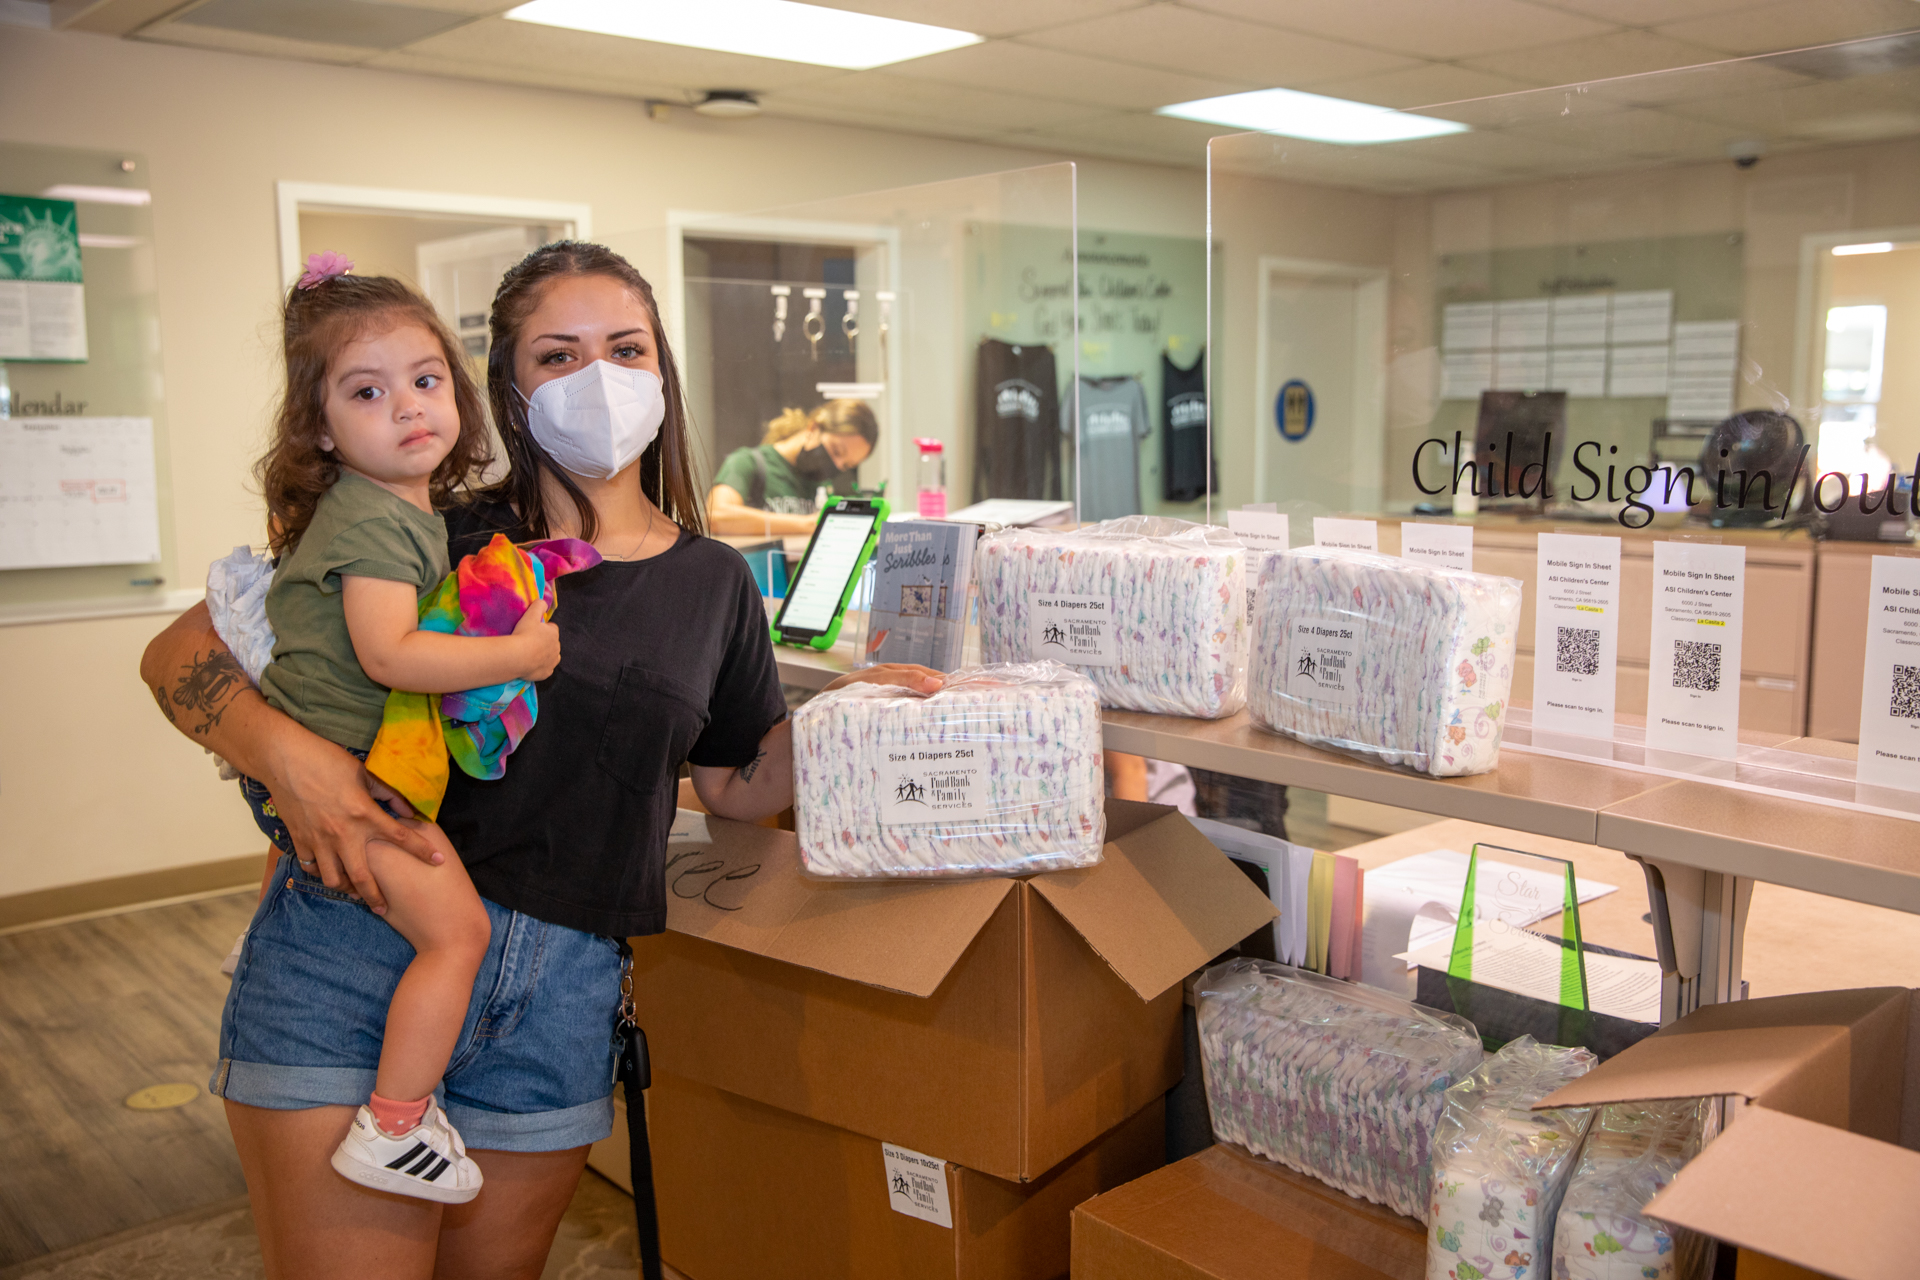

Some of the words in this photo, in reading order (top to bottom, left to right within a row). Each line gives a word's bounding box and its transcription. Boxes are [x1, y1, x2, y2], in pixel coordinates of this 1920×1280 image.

[0, 390, 88, 416] alendar
[1412, 431, 1554, 500] Child
[1570, 441, 1700, 529] Sign
[885, 532, 908, 543] More
[909, 530, 932, 542] Than
[893, 543, 913, 555] Just
[1449, 550, 1464, 558] Sheet
[884, 547, 936, 573] Scribbles
[1569, 561, 1583, 569] Sign
[1559, 576, 1589, 584] Children's
[1663, 569, 1686, 577] Mobile
[1687, 571, 1703, 580] Sign
[1714, 573, 1735, 581] Sheet
[1677, 587, 1709, 596] Children's
[1882, 586, 1910, 596] Mobile
[1038, 599, 1052, 607] Size
[1060, 600, 1087, 610] Diapers
[1089, 601, 1105, 610] 25ct
[1899, 606, 1920, 615] Child
[1064, 618, 1107, 626] SACRAMENTO
[1298, 625, 1310, 634] Size
[1310, 626, 1315, 634] 4
[1316, 627, 1339, 638] Diapers
[1339, 629, 1353, 639] 25ct
[1882, 628, 1918, 637] Sacramento,
[1316, 647, 1353, 657] SACRAMENTO
[1318, 682, 1345, 691] SERVICES
[1661, 718, 1680, 726] Please
[888, 753, 907, 762] Size
[909, 752, 915, 760] 4
[918, 751, 952, 761] Diapers
[955, 749, 974, 758] 25ct
[1875, 750, 1898, 759] Please
[923, 769, 978, 777] SACRAMENTO
[936, 788, 966, 801] Family
[931, 802, 973, 810] SERVICES
[1498, 871, 1540, 900] Star
[884, 1148, 895, 1158] Size
[900, 1153, 919, 1165] Diapers
[906, 1170, 939, 1184] SACRAMENTO
[914, 1201, 939, 1213] SERVICES
